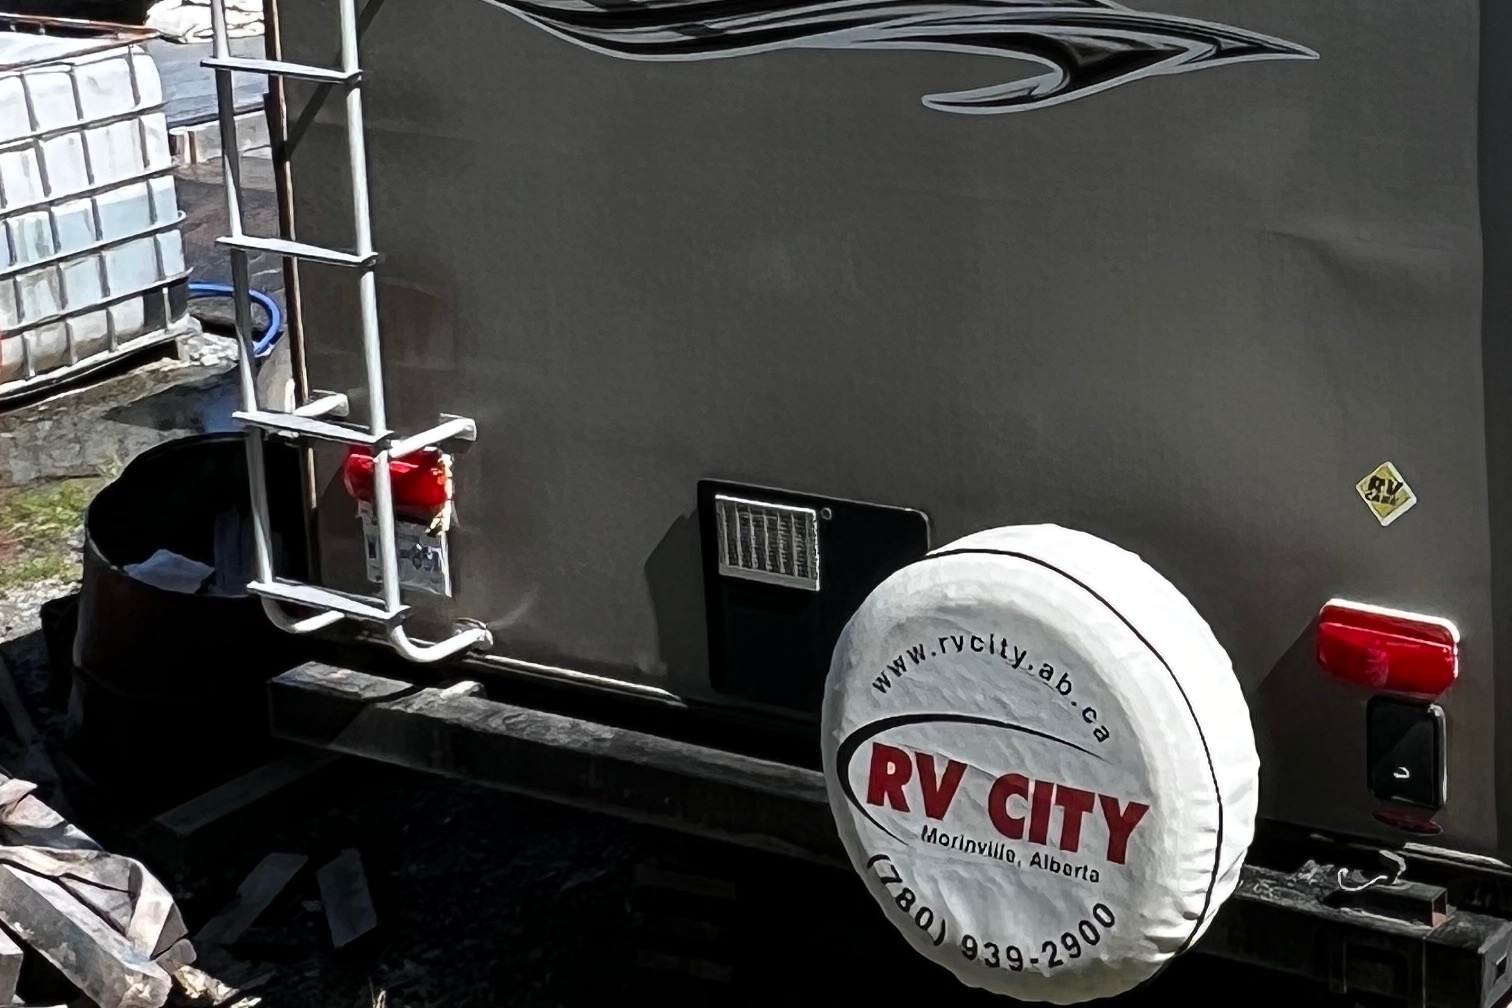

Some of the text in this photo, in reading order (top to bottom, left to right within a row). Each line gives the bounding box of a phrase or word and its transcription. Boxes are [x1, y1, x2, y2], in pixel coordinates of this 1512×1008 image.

[1368, 475, 1403, 495] RV
[871, 631, 1111, 744] www.rvcity.ab.ca
[866, 741, 1151, 866] RV CITY
[867, 853, 1116, 973] (780) 939-2900
[1029, 851, 1101, 884] Alberta
